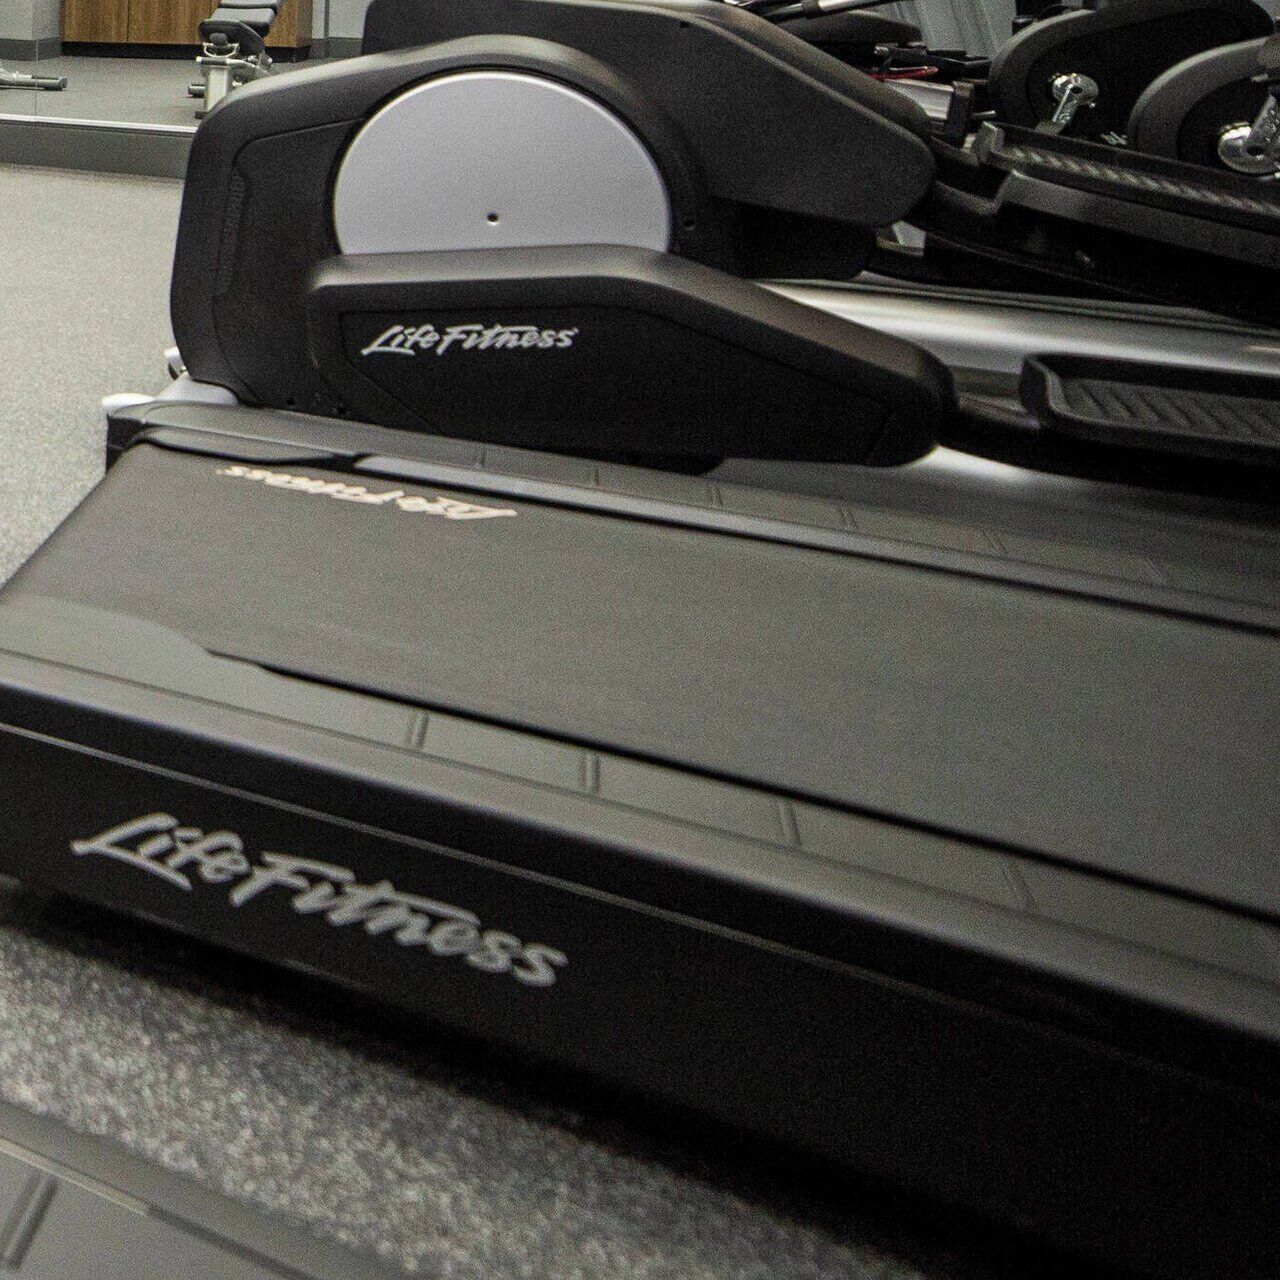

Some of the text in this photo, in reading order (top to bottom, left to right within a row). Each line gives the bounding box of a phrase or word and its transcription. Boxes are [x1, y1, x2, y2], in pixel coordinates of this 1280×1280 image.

[361, 324, 579, 356] Life Fitness
[70, 812, 568, 987] Life Fitness
